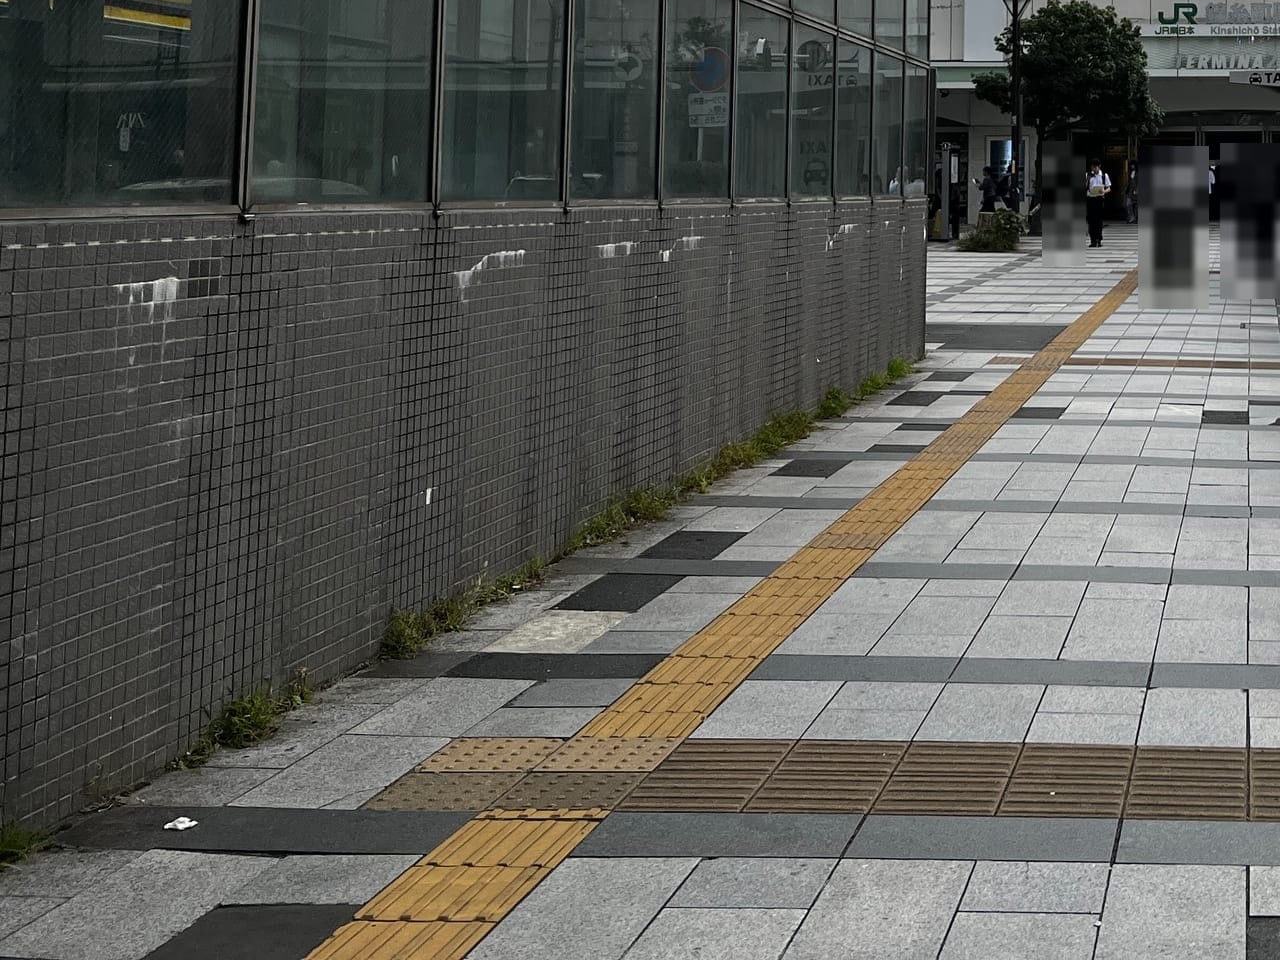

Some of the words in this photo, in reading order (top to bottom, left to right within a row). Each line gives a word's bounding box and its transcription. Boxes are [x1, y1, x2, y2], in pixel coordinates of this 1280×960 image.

[1158, 2, 1198, 25] JR
[1154, 26, 1195, 36] JR東日本
